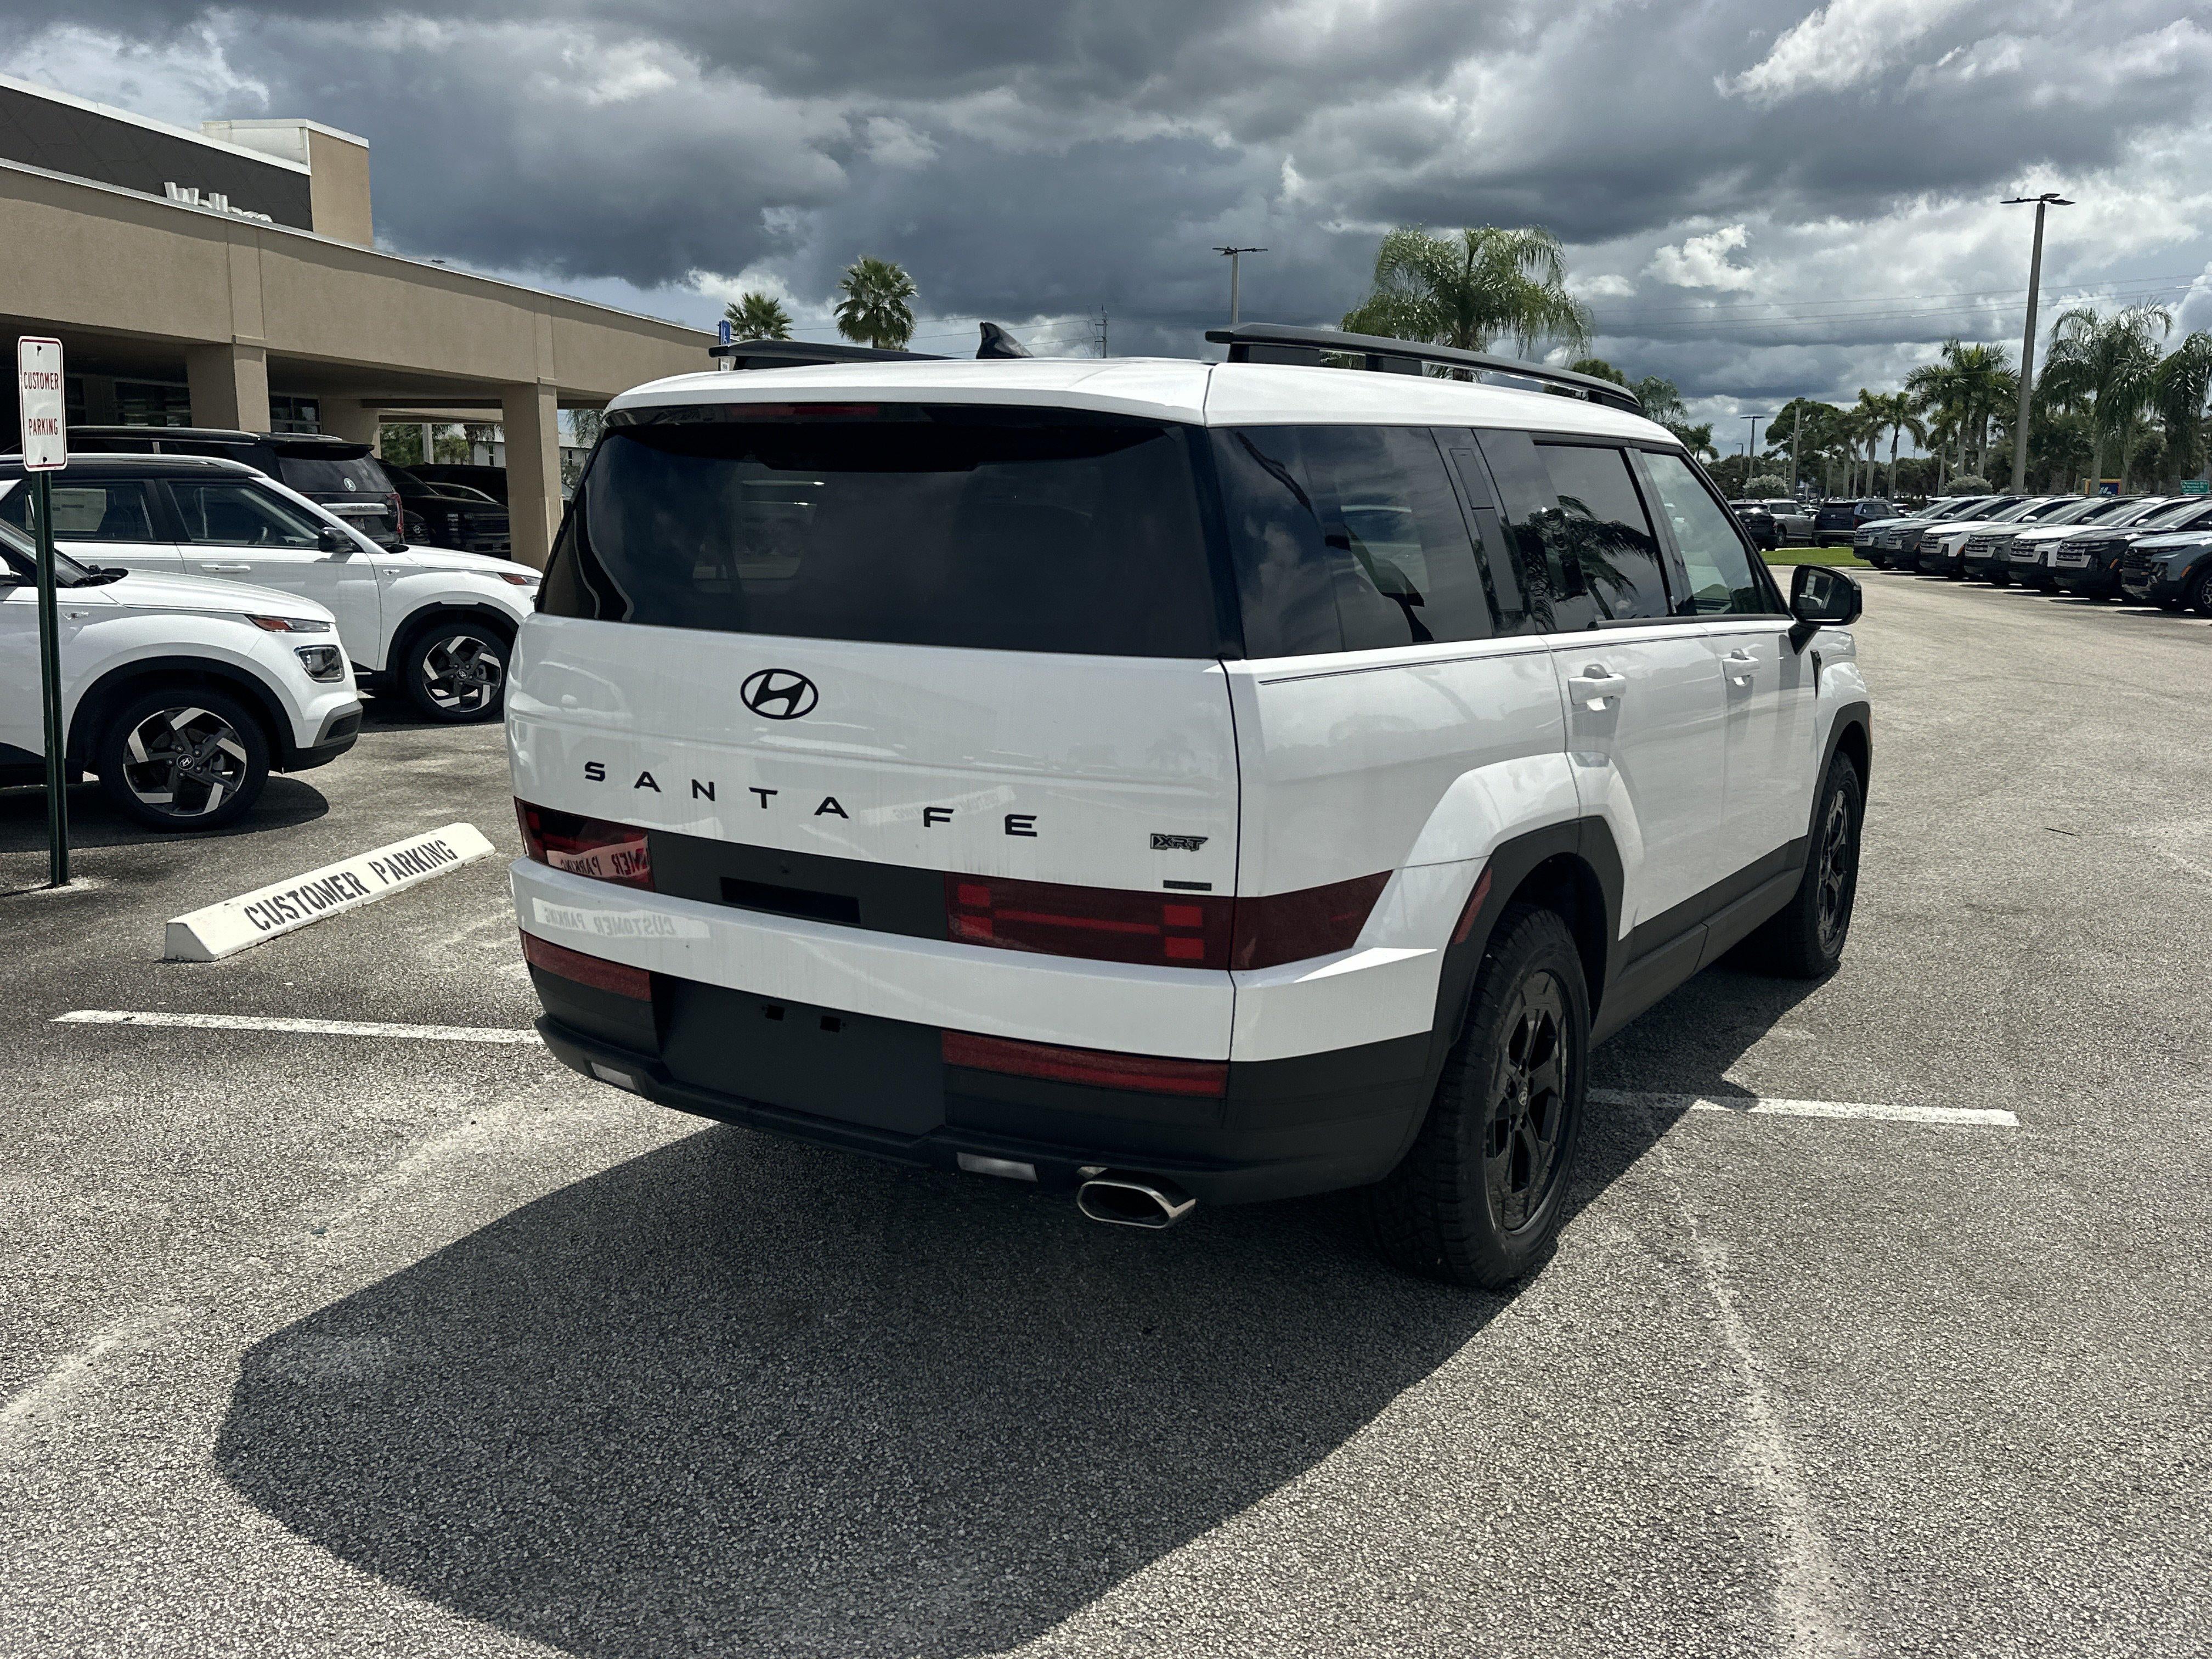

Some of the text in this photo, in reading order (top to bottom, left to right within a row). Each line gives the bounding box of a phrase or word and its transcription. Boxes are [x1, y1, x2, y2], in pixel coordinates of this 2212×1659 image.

[24, 371, 59, 390] CUSTOMER
[29, 418, 58, 436] PARKING
[584, 761, 1037, 837] SANTA FE
[1150, 833, 1209, 851] XRT
[244, 839, 459, 931] CUSTOMER PARKING
